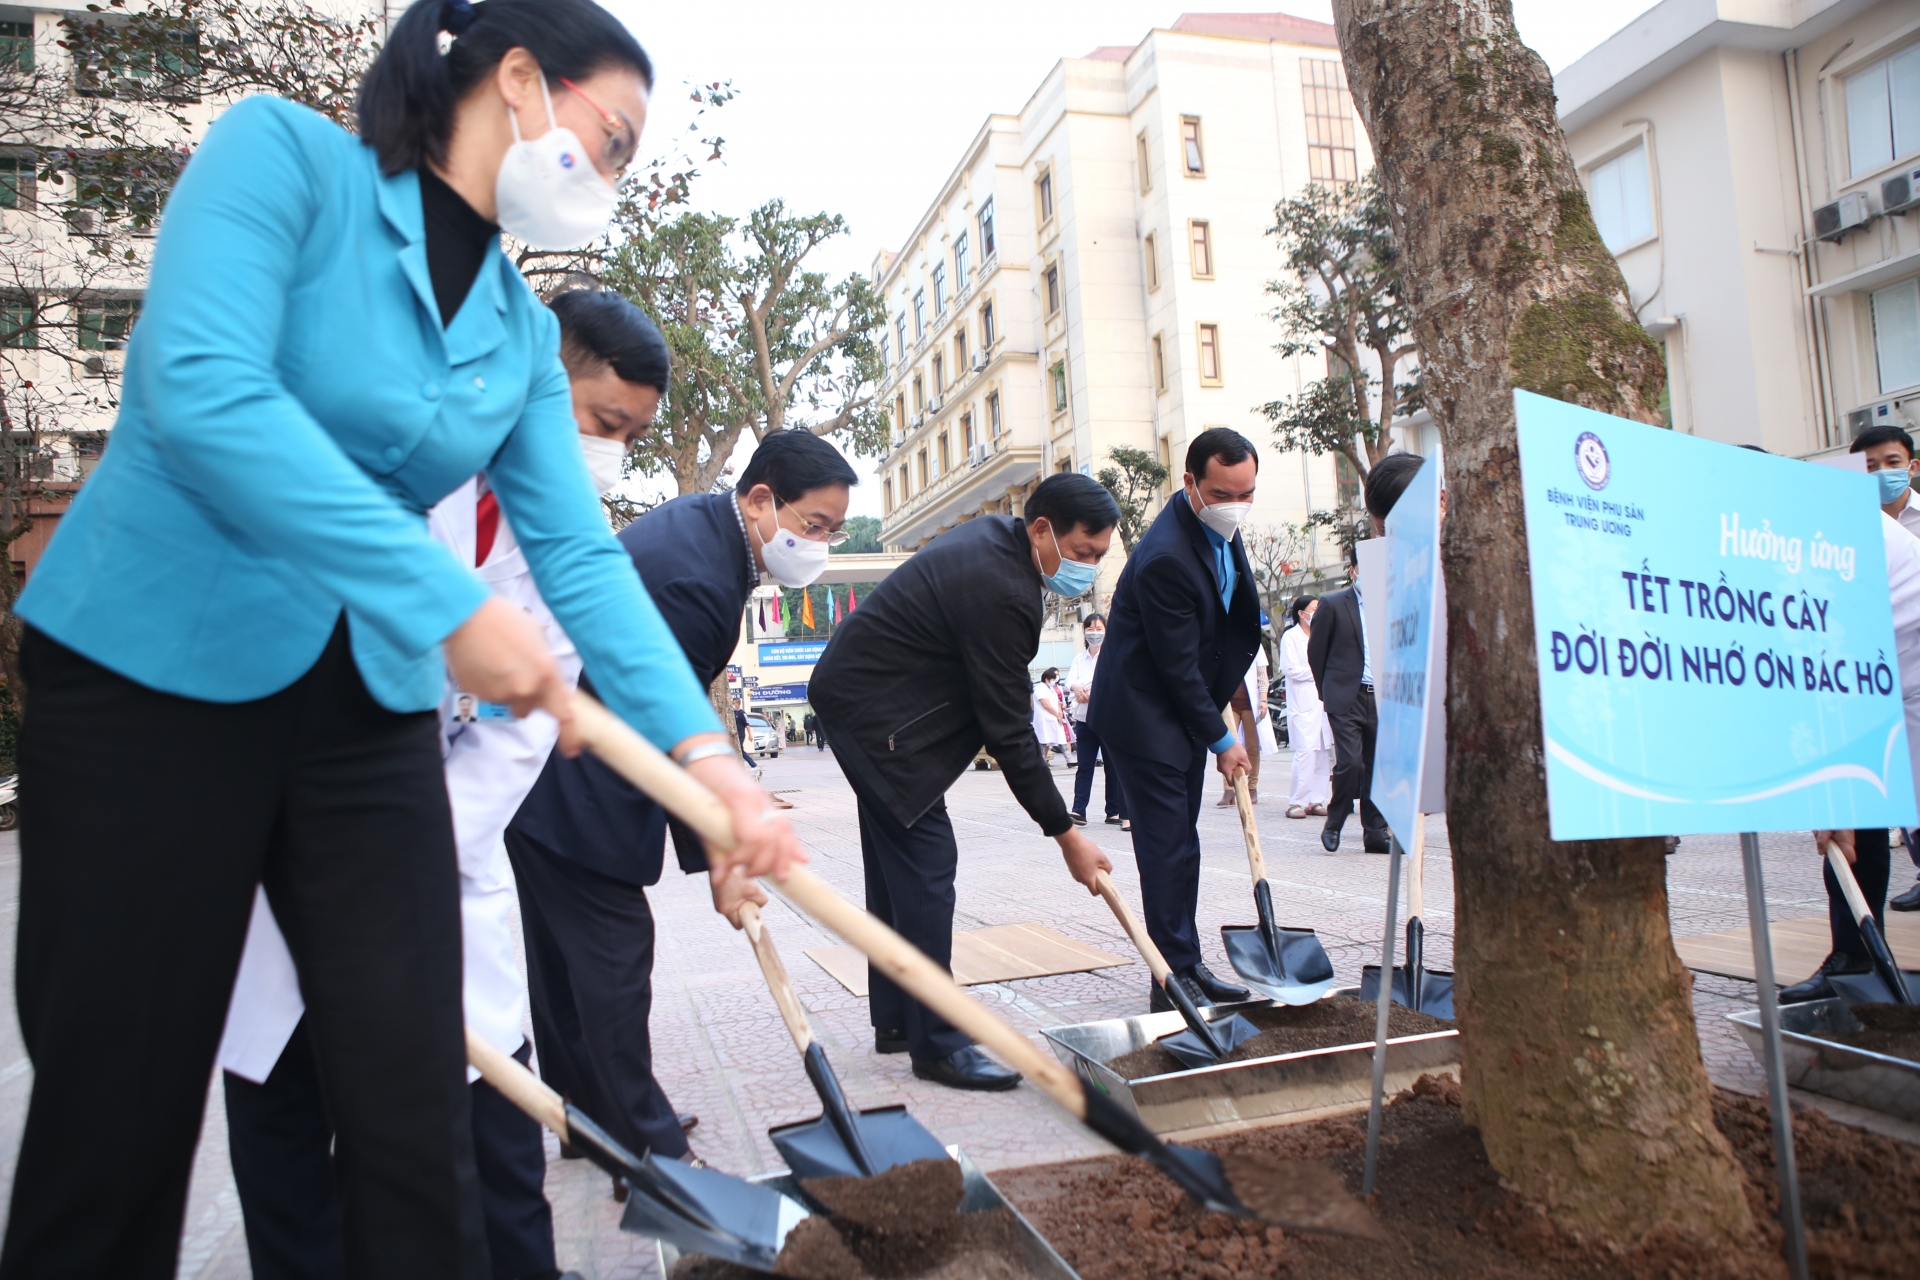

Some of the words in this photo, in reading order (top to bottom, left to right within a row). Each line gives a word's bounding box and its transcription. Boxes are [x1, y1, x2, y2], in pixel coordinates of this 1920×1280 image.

[1547, 486, 1574, 508] BỆNH
[1576, 494, 1600, 514] VIỆN
[1602, 501, 1622, 520] PHỤ
[1624, 502, 1645, 521] SẢN
[1564, 512, 1599, 531] TRUNG
[1720, 511, 1802, 574] Hưởng
[1810, 530, 1856, 582] ứng
[1621, 557, 1670, 614] TẾT
[1679, 569, 1776, 627] TRỒNG
[1782, 588, 1829, 633] CÂY
[1550, 622, 1609, 676] ĐỜI
[1617, 630, 1673, 681] ĐỜI
[1681, 640, 1746, 686] NHỚ
[1754, 647, 1796, 690] ƠN
[1802, 649, 1850, 694] BÁC
[1855, 648, 1894, 697] HỒ
